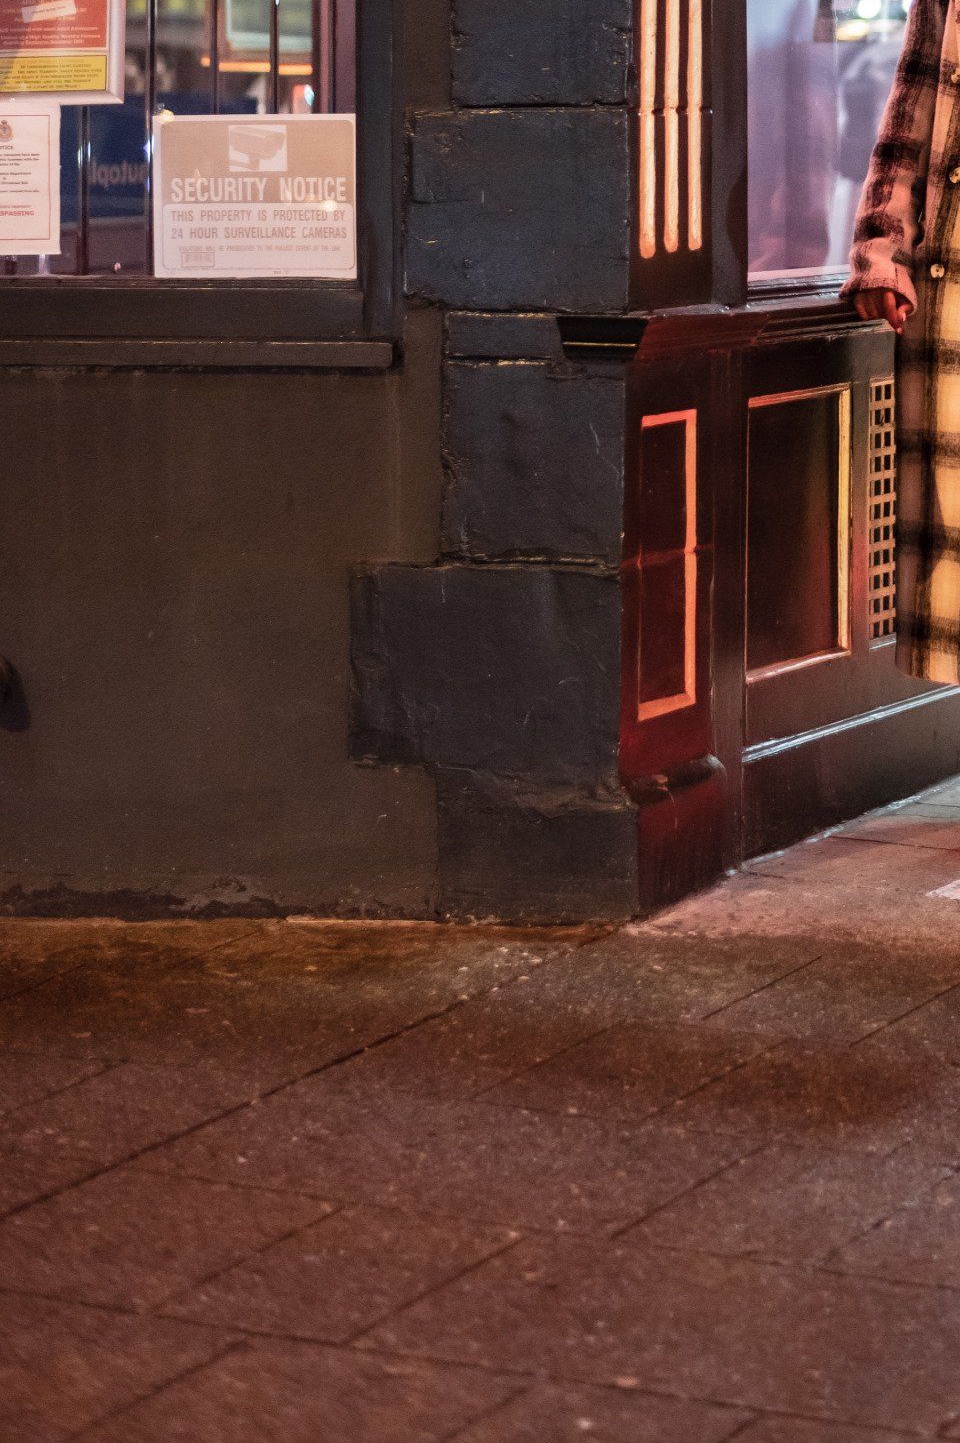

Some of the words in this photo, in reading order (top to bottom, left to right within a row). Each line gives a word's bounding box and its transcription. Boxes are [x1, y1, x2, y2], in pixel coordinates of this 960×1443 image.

[170, 177, 268, 203] SECURITY
[279, 176, 347, 203] NOTICE
[171, 210, 194, 222] THIS
[201, 209, 252, 222] PROPERTY
[257, 209, 267, 221] IS
[273, 209, 329, 222] PROTECTED
[333, 209, 346, 221] BY
[171, 227, 184, 240] 24
[189, 227, 218, 239] HOUR
[224, 226, 297, 239] SURVEILLANCE
[302, 226, 347, 239] CAMERAS
